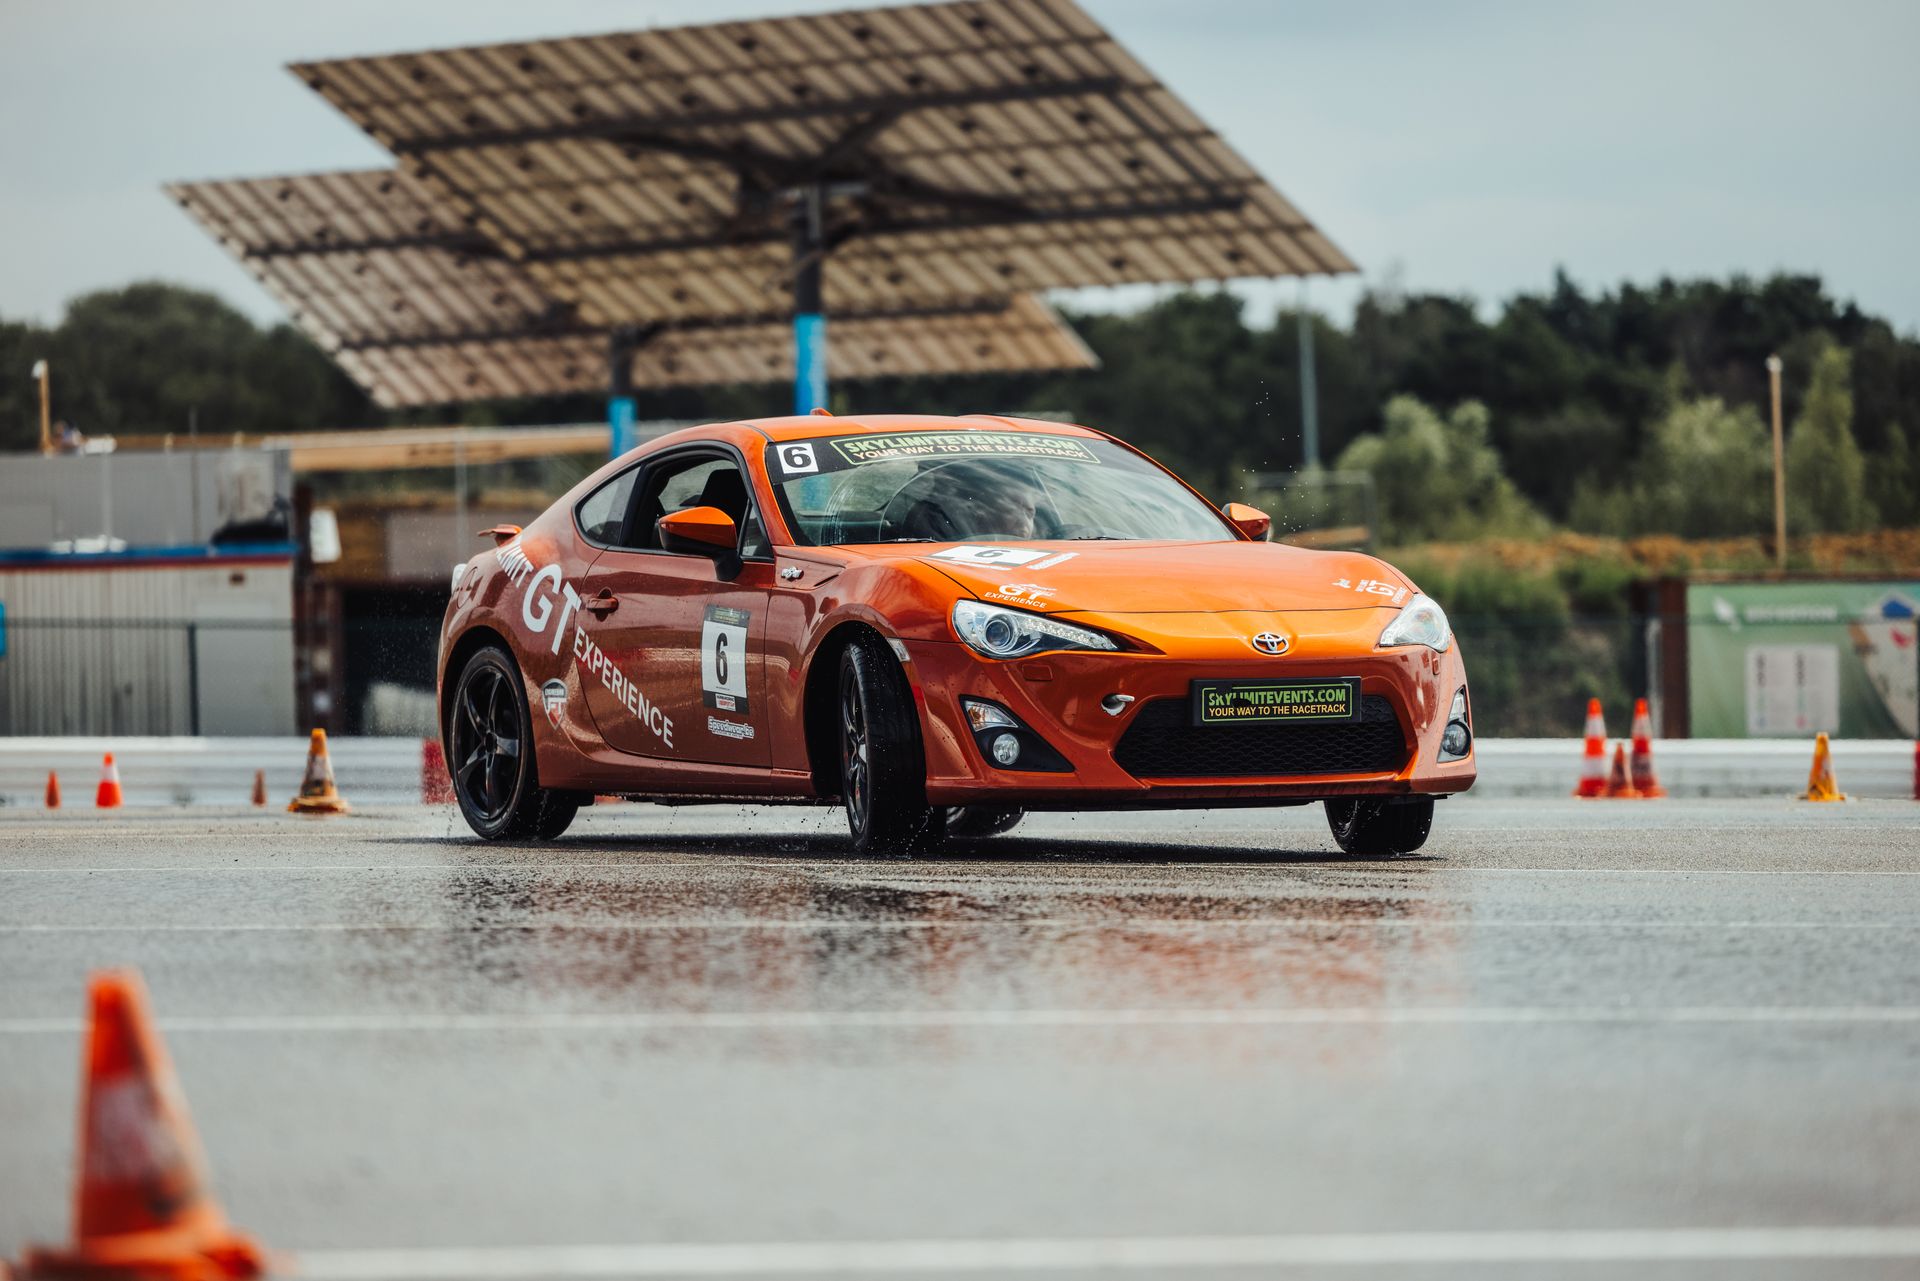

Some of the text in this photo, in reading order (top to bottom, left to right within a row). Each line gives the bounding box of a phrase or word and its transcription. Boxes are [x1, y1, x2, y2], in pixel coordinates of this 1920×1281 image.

[844, 434, 1081, 452] SKYLIMITEVENTS.COM
[853, 444, 1089, 460] YOUR WAY TO THE RACETRACK
[783, 446, 811, 468] 6
[522, 563, 582, 656] GT
[984, 591, 1048, 608] EXPERIENCE
[715, 632, 728, 685] 6
[573, 626, 674, 749] EXPERIENCE
[1209, 703, 1346, 717] YOUR WAY TO THE RACETRACK
